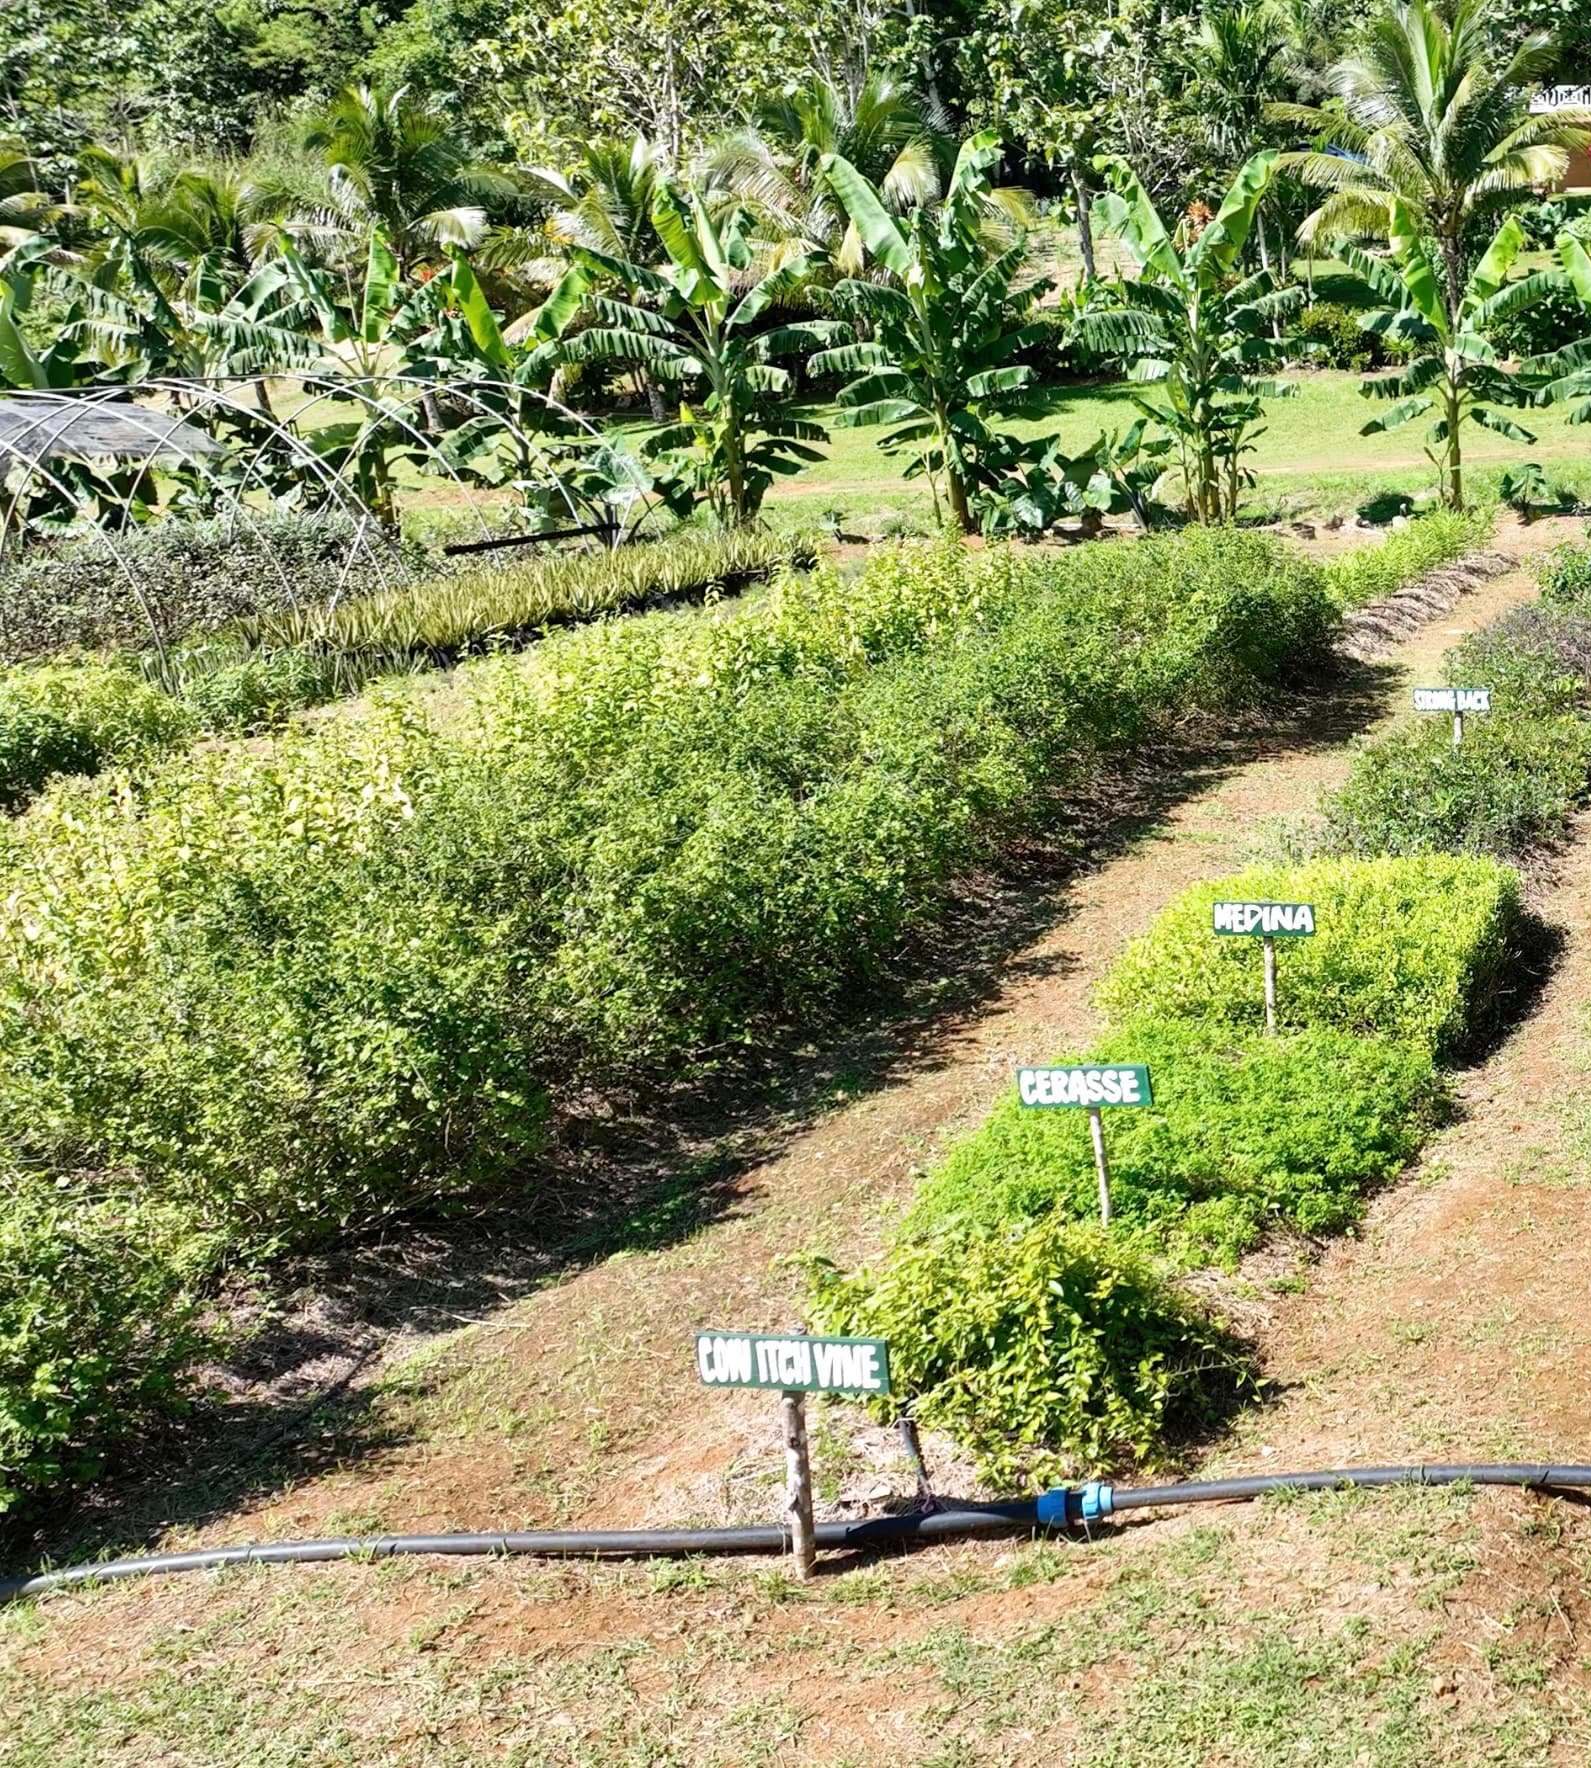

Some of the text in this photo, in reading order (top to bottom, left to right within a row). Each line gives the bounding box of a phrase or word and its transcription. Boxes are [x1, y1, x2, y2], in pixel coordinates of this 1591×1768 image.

[1456, 690, 1491, 711] BACK
[1214, 903, 1315, 933] MEDINA
[1019, 1070, 1141, 1105] CERASSE
[698, 1337, 881, 1389] COW ITCH VINE
